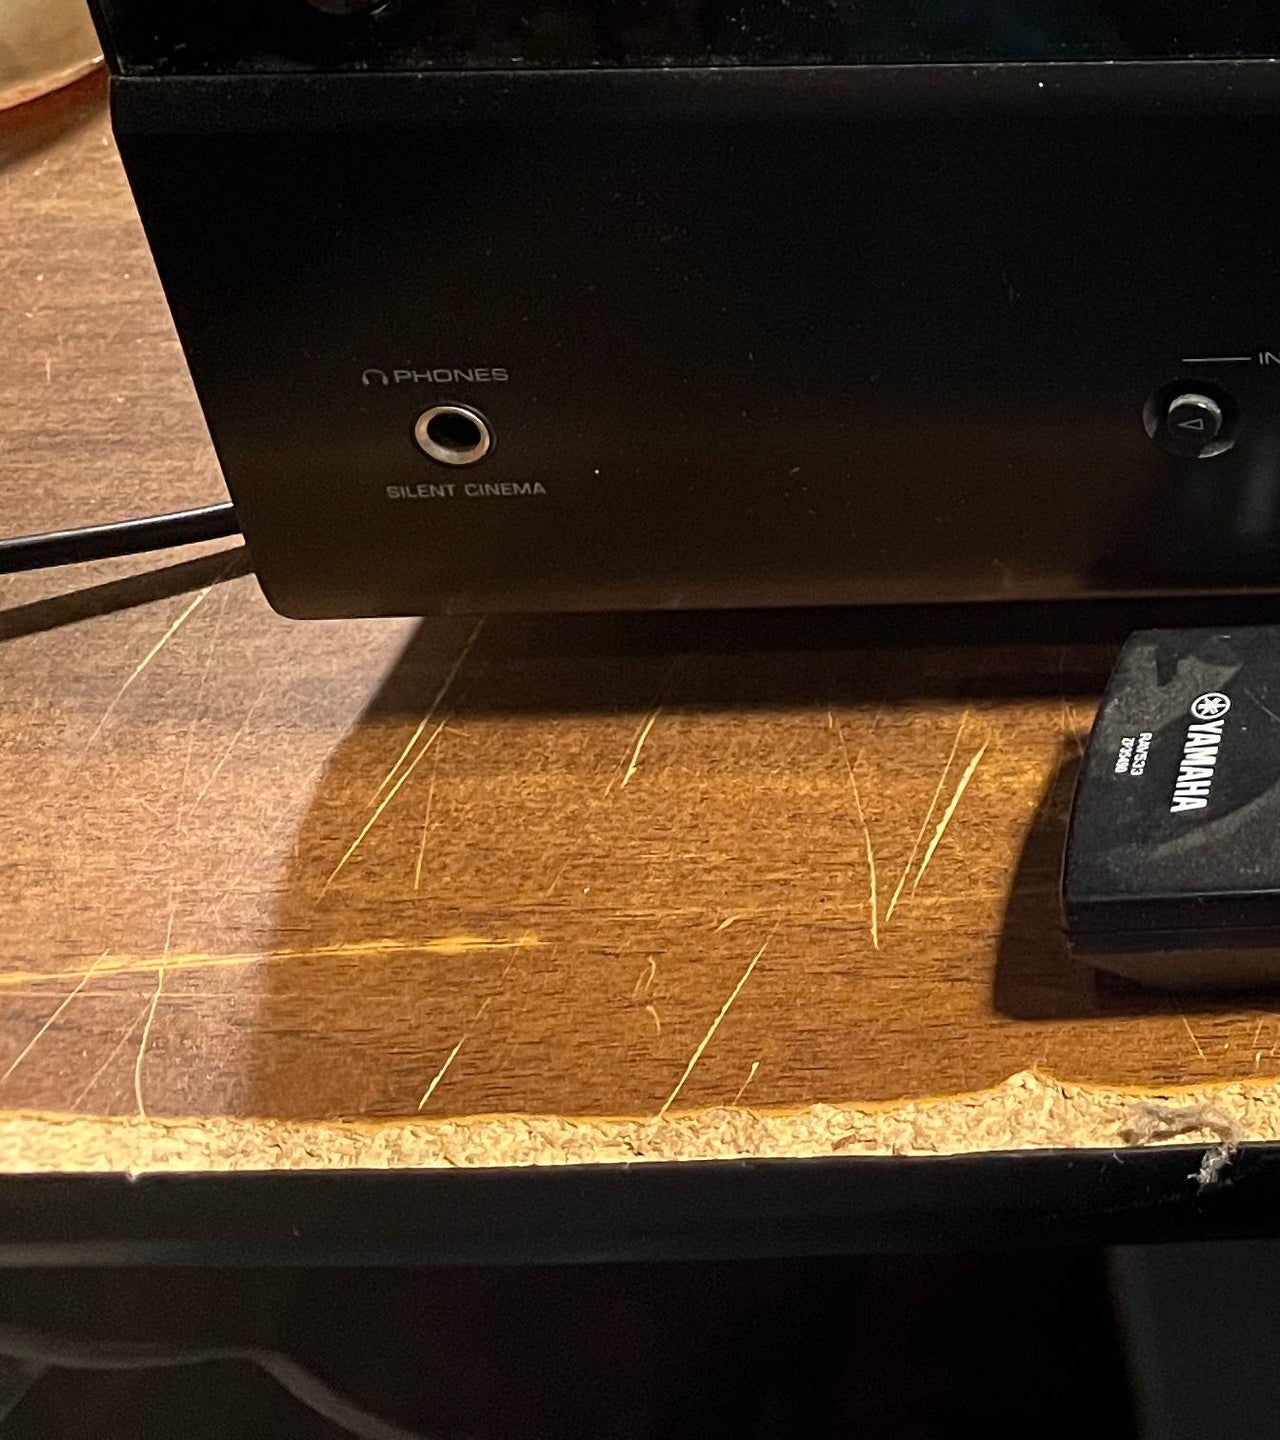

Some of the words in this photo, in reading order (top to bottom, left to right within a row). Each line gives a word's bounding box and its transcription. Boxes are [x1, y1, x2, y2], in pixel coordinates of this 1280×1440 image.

[393, 368, 509, 384] PHONES
[385, 484, 456, 500] SILENT
[464, 482, 548, 498] CINEMA
[1169, 719, 1226, 813] YAMAHA
